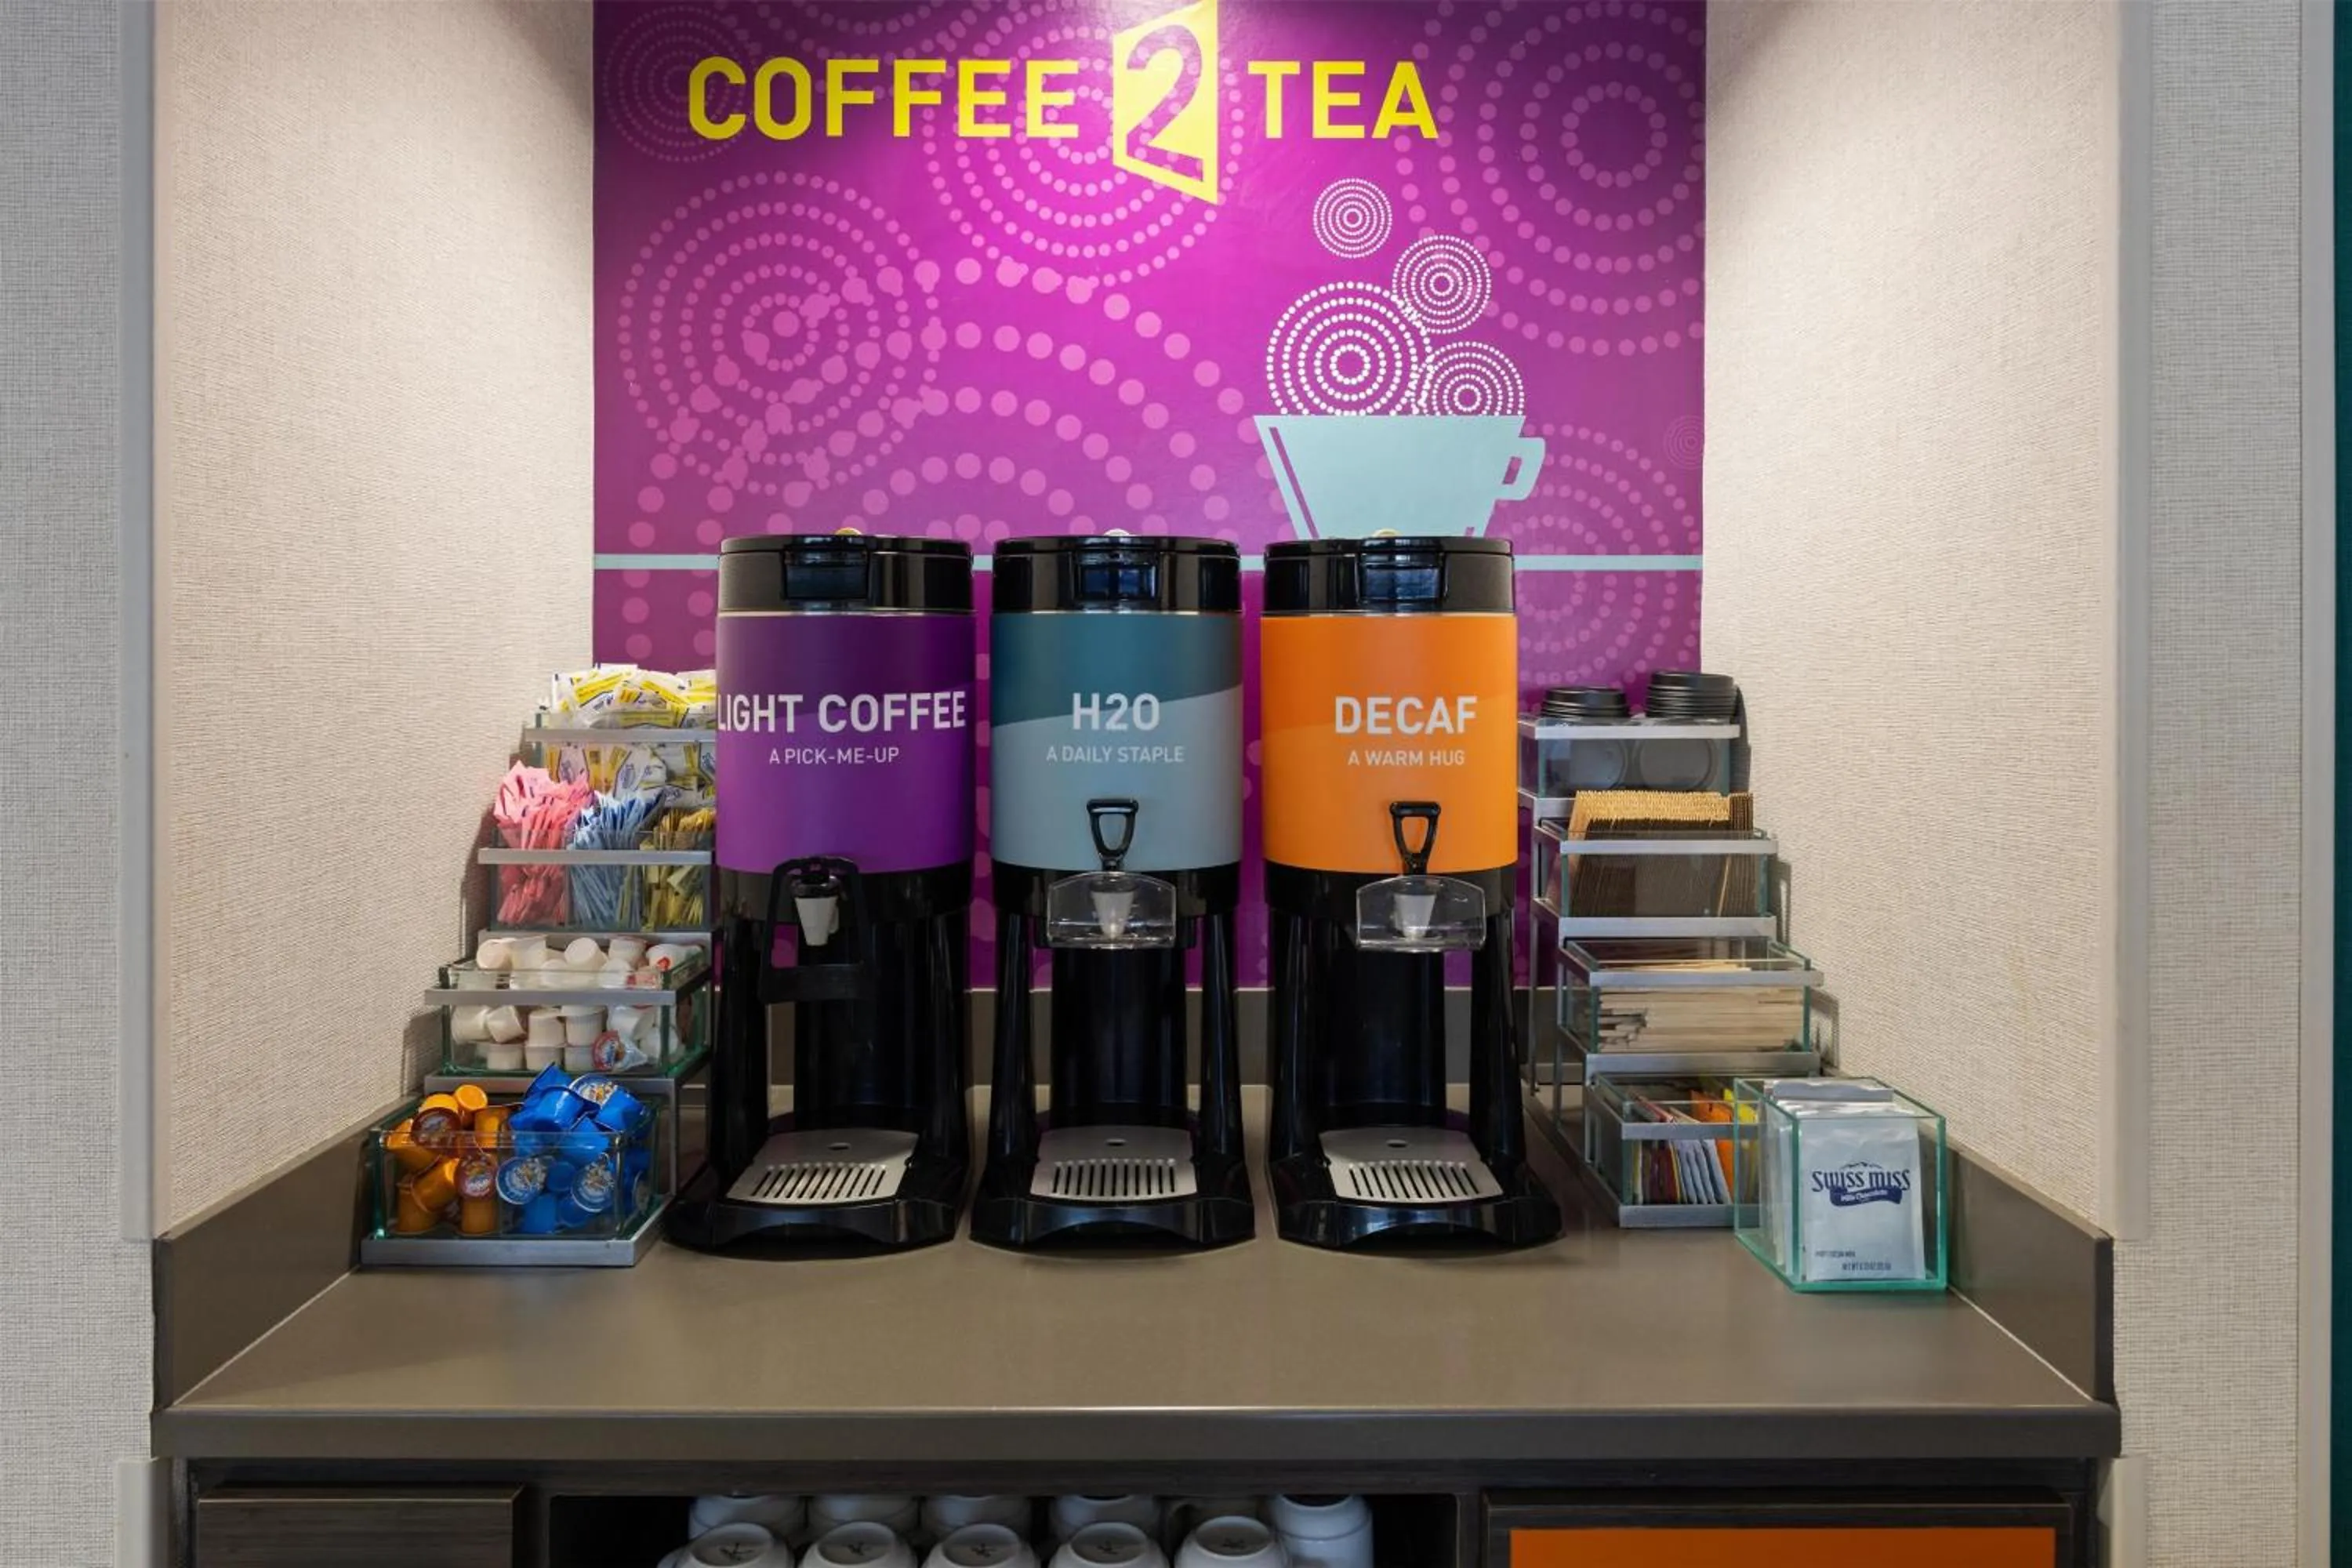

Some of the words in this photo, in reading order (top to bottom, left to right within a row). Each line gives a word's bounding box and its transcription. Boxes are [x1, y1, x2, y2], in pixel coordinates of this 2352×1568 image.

[688, 56, 1080, 140] COFFEE
[1126, 24, 1203, 183] 2
[1248, 60, 1439, 139] TEA
[717, 694, 804, 733] LIGHT
[818, 691, 967, 733] COFFEE
[1335, 695, 1478, 735] DECAF
[769, 748, 781, 764] A
[785, 747, 900, 764] PICK-ME-UP
[1046, 746, 1058, 763] A
[1062, 746, 1113, 763] DAILY
[1117, 746, 1185, 763] STAPLE
[1348, 750, 1360, 766] A
[1365, 750, 1424, 766] WARM
[1429, 750, 1465, 766] HUG
